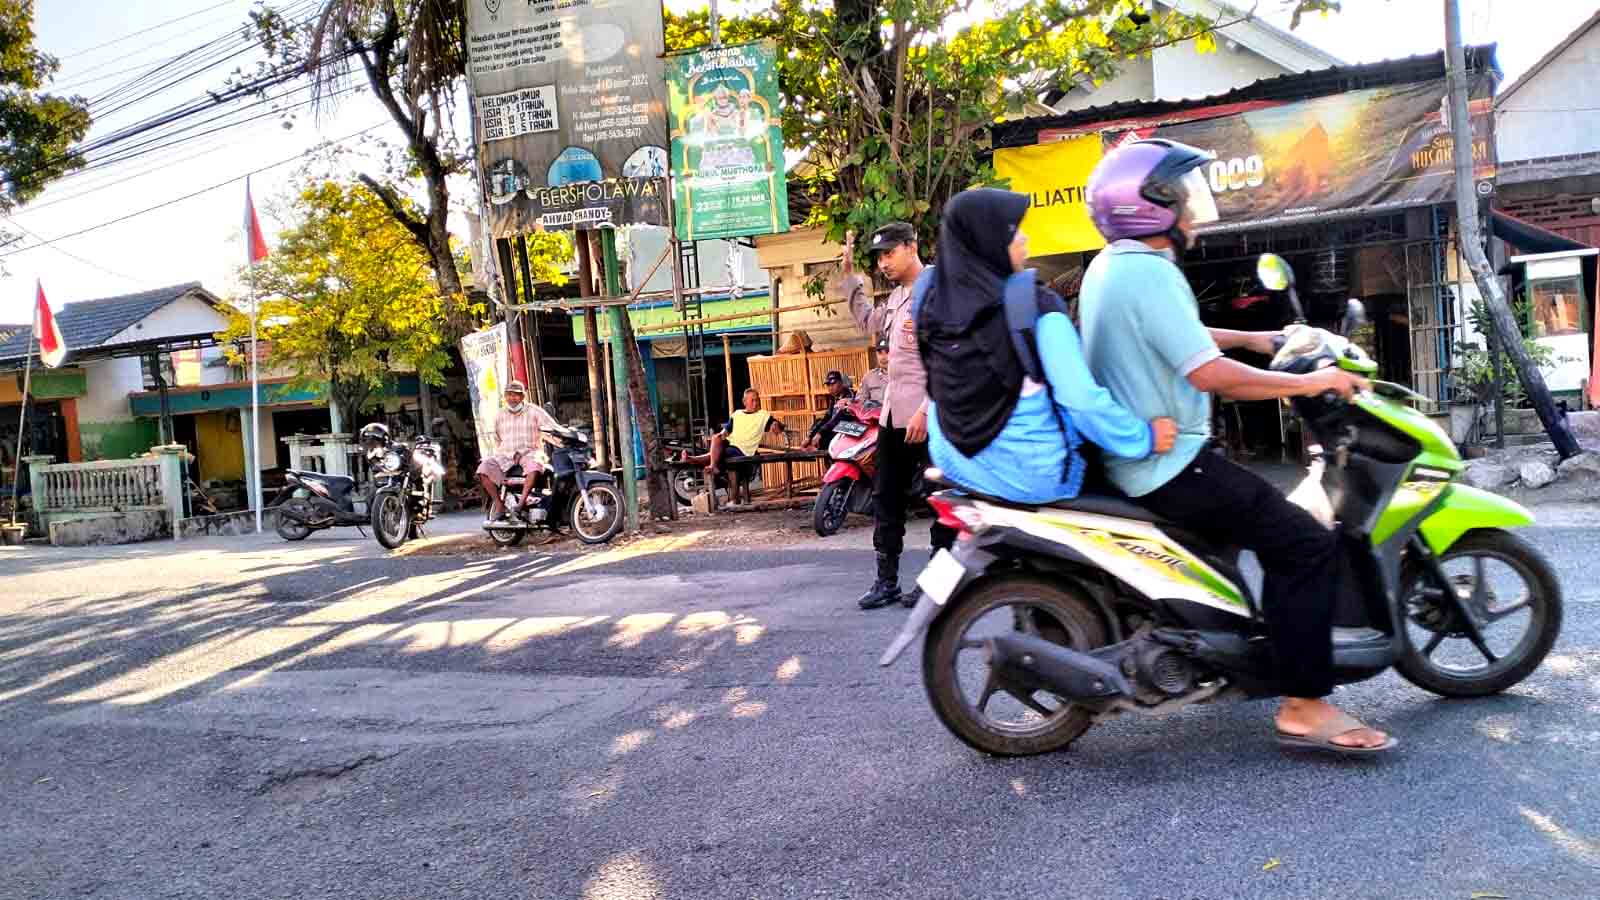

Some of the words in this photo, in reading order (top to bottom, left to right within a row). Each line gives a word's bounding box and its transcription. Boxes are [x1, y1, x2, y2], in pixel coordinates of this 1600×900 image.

[482, 93, 519, 109] KELOMPOK
[519, 89, 541, 102] UMUR
[483, 107, 502, 119] USIA
[521, 99, 545, 112] TAHUN
[484, 117, 503, 129] USIA
[527, 108, 552, 121] TAHUN
[486, 127, 504, 139] USIA
[528, 119, 553, 131] TAHUN
[540, 178, 662, 208] BERSHOLAWAT
